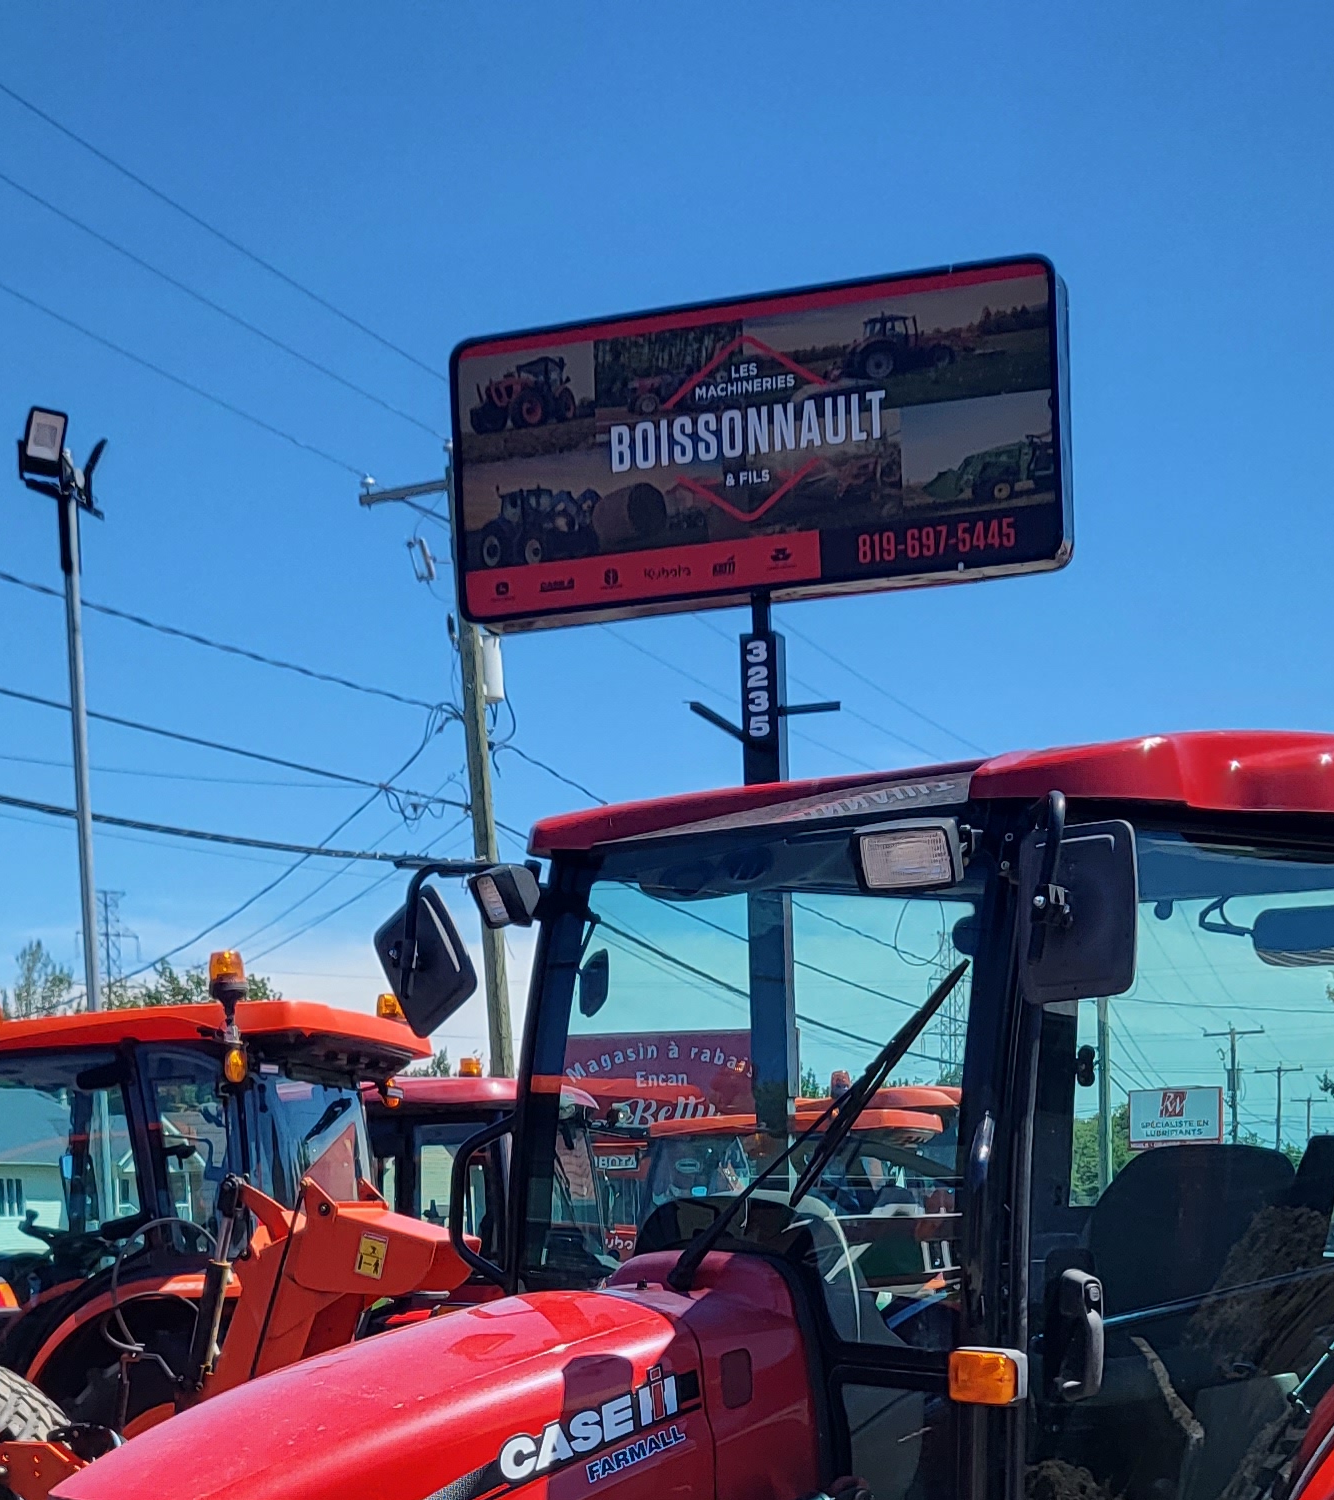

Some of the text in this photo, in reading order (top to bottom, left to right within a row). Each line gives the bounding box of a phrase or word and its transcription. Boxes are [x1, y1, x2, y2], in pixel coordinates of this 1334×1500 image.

[694, 373, 796, 401] MACHINERIES
[731, 362, 758, 379] LES
[609, 389, 886, 474] BOISSONNAULT
[725, 469, 771, 487] & FILS
[857, 516, 1016, 564] 819-697-5445
[745, 640, 770, 738] 3235
[565, 1040, 658, 1084] Magasin
[667, 1040, 680, 1059] à
[635, 1071, 689, 1088] Encan
[1140, 1118, 1210, 1129] SPÉCIALISTE EN
[499, 1394, 635, 1481] CASE
[585, 1424, 687, 1484] FARMALL
